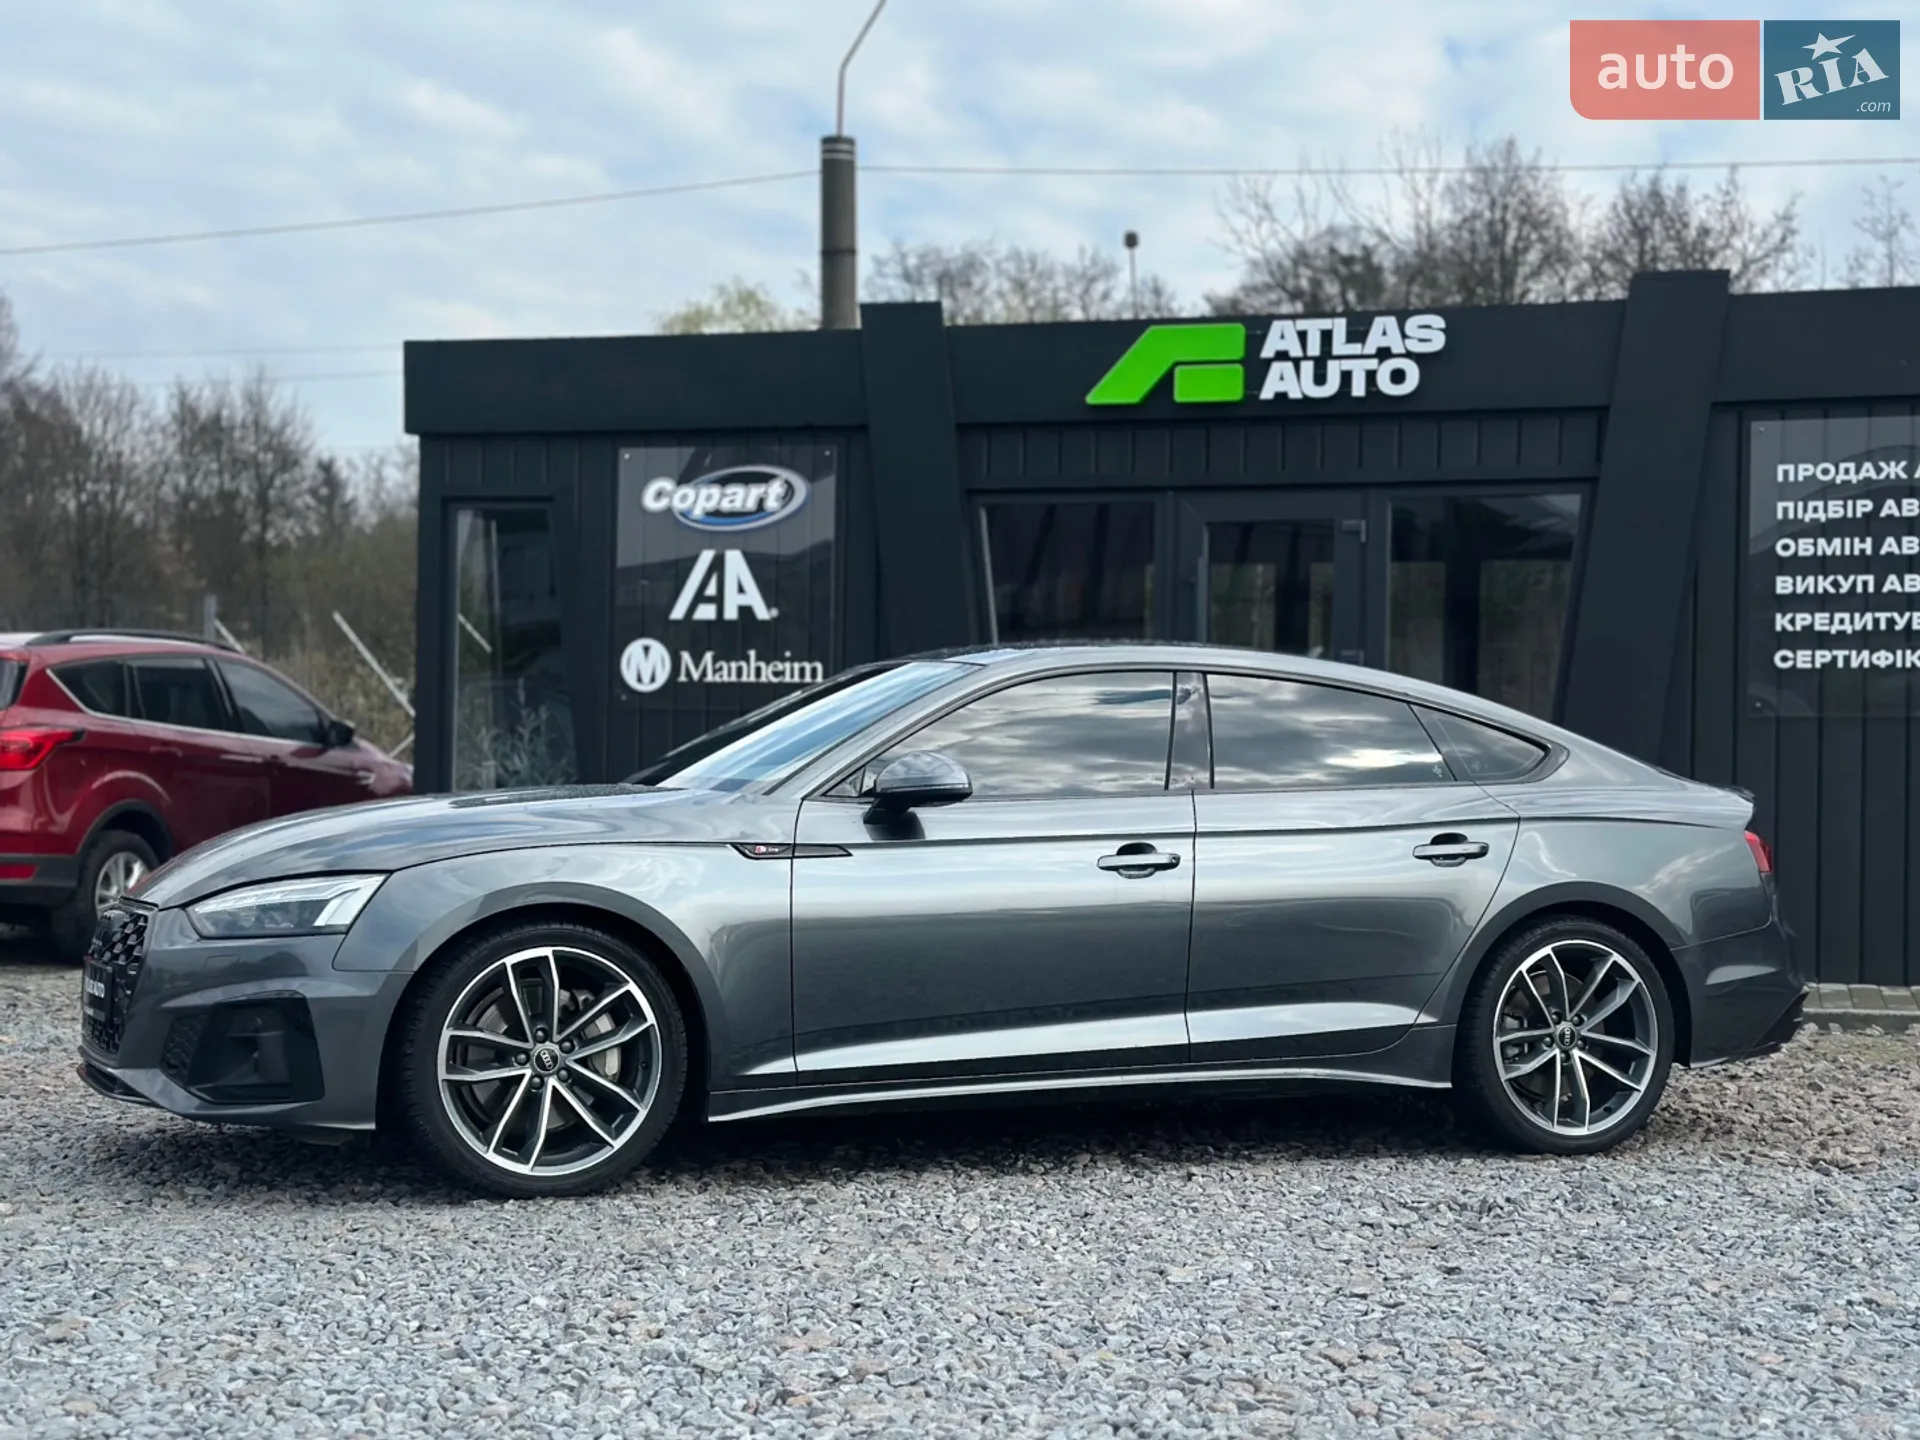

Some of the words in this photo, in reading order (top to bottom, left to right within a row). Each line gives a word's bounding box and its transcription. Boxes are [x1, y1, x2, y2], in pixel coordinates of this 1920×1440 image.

[1259, 314, 1446, 359] ATLAS
[1258, 357, 1421, 400] AUTO
[1776, 461, 1908, 484] ПРОДАЖ
[642, 475, 786, 520] Copart
[1776, 499, 1874, 523] ПІДБІР
[1775, 537, 1873, 557] ОБМІН
[1775, 575, 1875, 595] ВИКУП
[677, 649, 824, 684] Manheim
